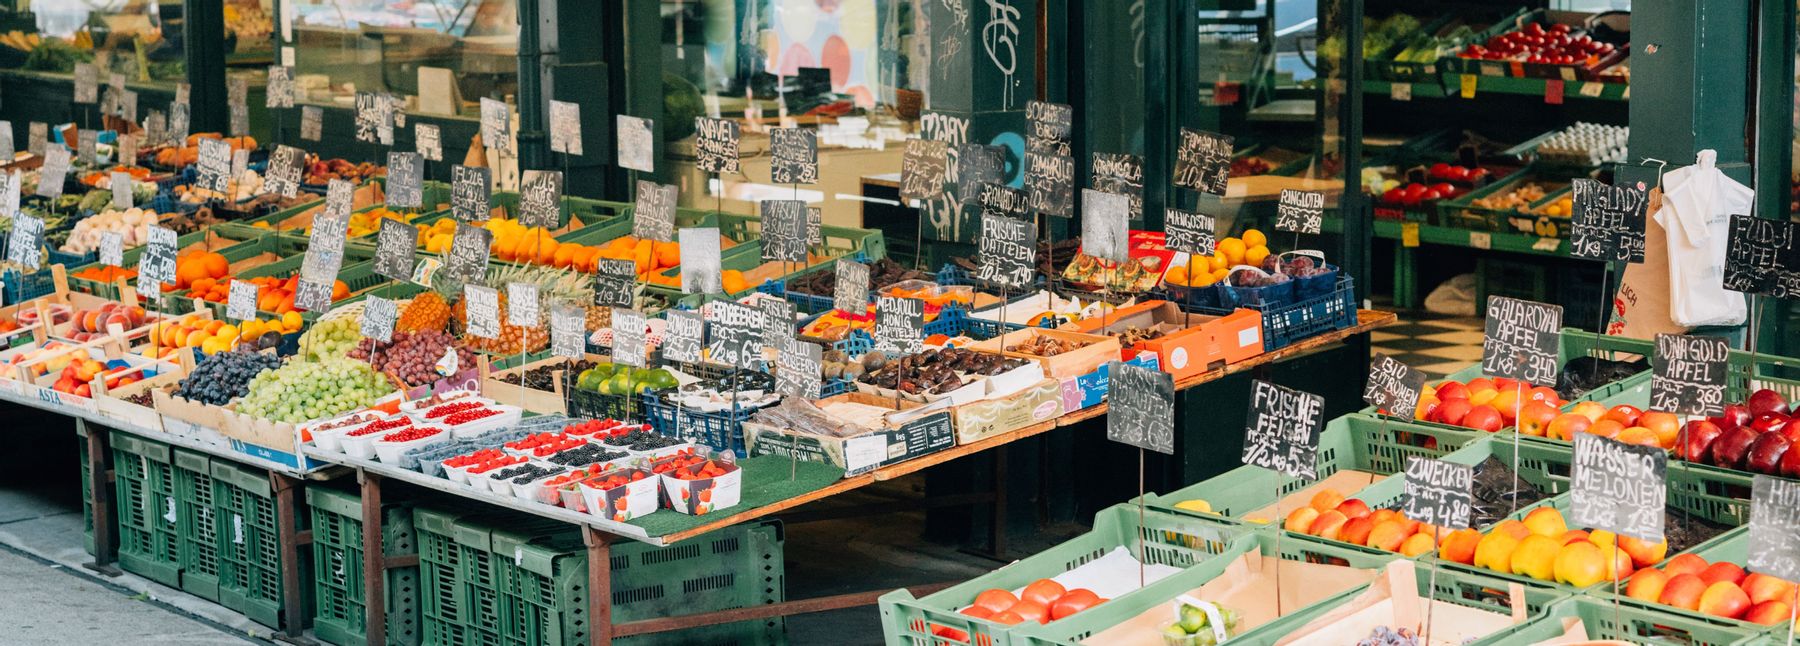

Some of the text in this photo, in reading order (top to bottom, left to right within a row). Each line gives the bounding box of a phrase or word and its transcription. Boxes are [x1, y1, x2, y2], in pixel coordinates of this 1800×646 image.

[698, 118, 733, 142] NAVEL
[456, 166, 484, 186] FLUG
[1281, 189, 1324, 208] RINGLOTEN
[983, 218, 1025, 241] FRISCHE
[1167, 208, 1215, 233] MANGOSTIN
[981, 236, 1036, 263] DATTELEN
[760, 299, 793, 320] FRISCHE
[883, 313, 912, 329] HONIG
[763, 314, 795, 338] EIGEN
[876, 324, 921, 340] DATTELEN
[1382, 356, 1407, 380] BIO
[1369, 367, 1419, 406] ZITRONEN
[1254, 381, 1321, 425] FRISCHE
[1257, 412, 1311, 445] FEIGEN
[1407, 456, 1473, 493] ZWECKEN
[1576, 464, 1667, 507] MELONEN
